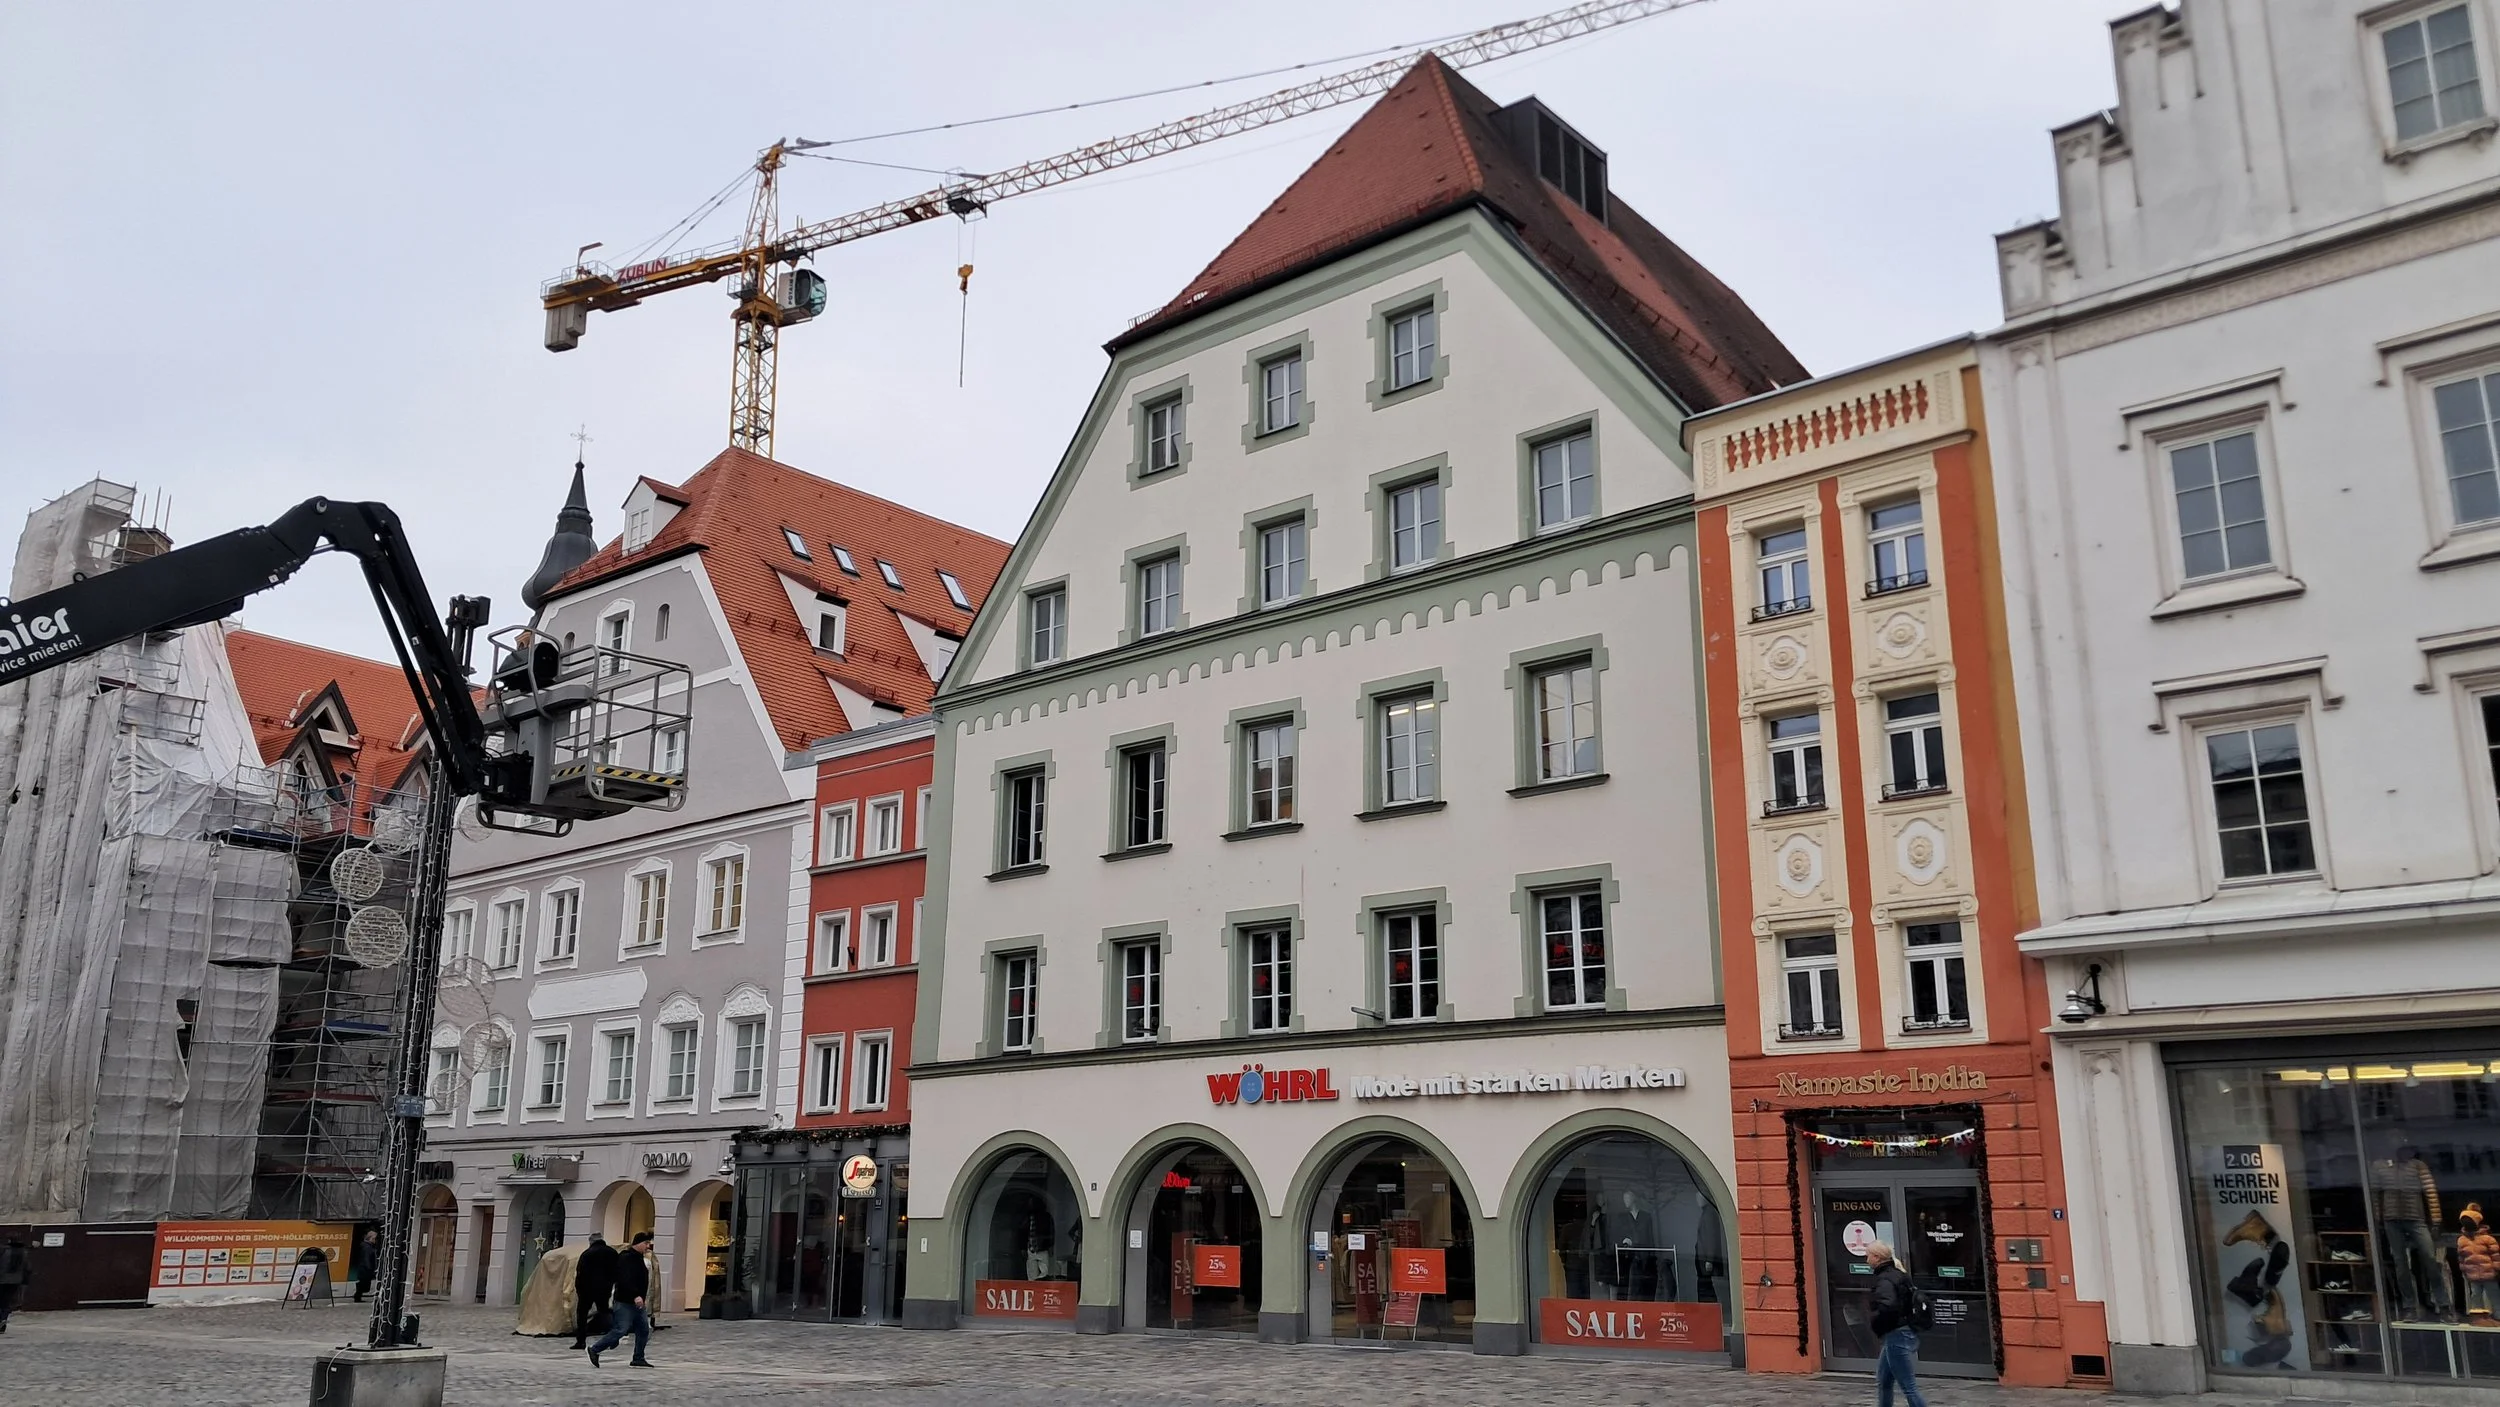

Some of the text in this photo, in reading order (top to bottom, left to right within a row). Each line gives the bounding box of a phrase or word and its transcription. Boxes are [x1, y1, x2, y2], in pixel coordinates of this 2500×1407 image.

[28, 634, 82, 662] mieten!
[1207, 1063, 1338, 1104] WÖHRL
[1351, 1064, 1685, 1098] Mode mit starken Marken
[1776, 1065, 1987, 1098] Namaste India
[643, 1152, 688, 1167] ORO VIVO
[2213, 1173, 2279, 1188] HERREN
[2219, 1190, 2279, 1204] SCHUHE
[1833, 1201, 1881, 1211] EINGANG
[1208, 1258, 1226, 1270] 25%
[1358, 1263, 1375, 1278] SA
[1407, 1263, 1429, 1275] 25%
[1358, 1279, 1376, 1294] LE
[986, 1288, 1034, 1311] SALE
[1042, 1293, 1062, 1306] 25%
[1566, 1309, 1646, 1340] SALE
[1659, 1317, 1689, 1332] 25%
